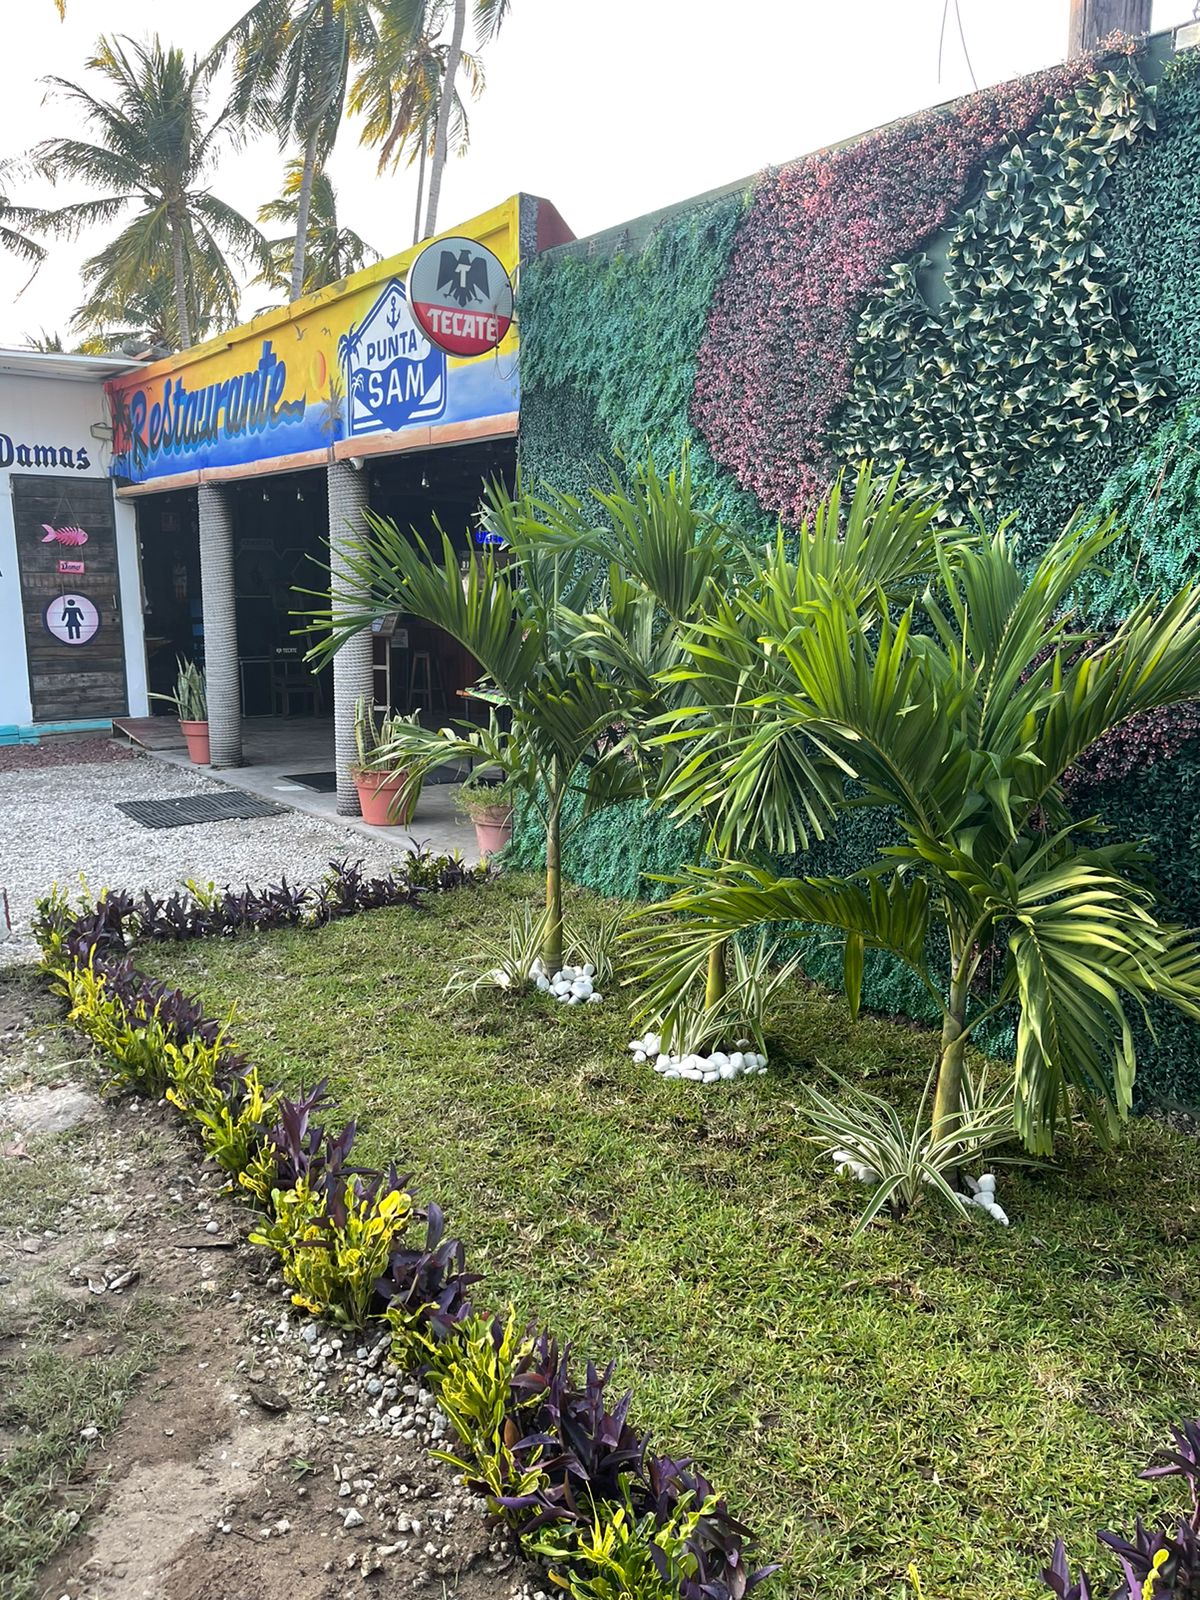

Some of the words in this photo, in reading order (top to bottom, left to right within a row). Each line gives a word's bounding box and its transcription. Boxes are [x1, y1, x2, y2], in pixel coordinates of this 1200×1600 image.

[427, 308, 498, 342] TECATE
[367, 329, 418, 366] PUNTA
[131, 340, 306, 468] Restaurante
[368, 362, 425, 409] SAM
[0, 432, 91, 471] Damas
